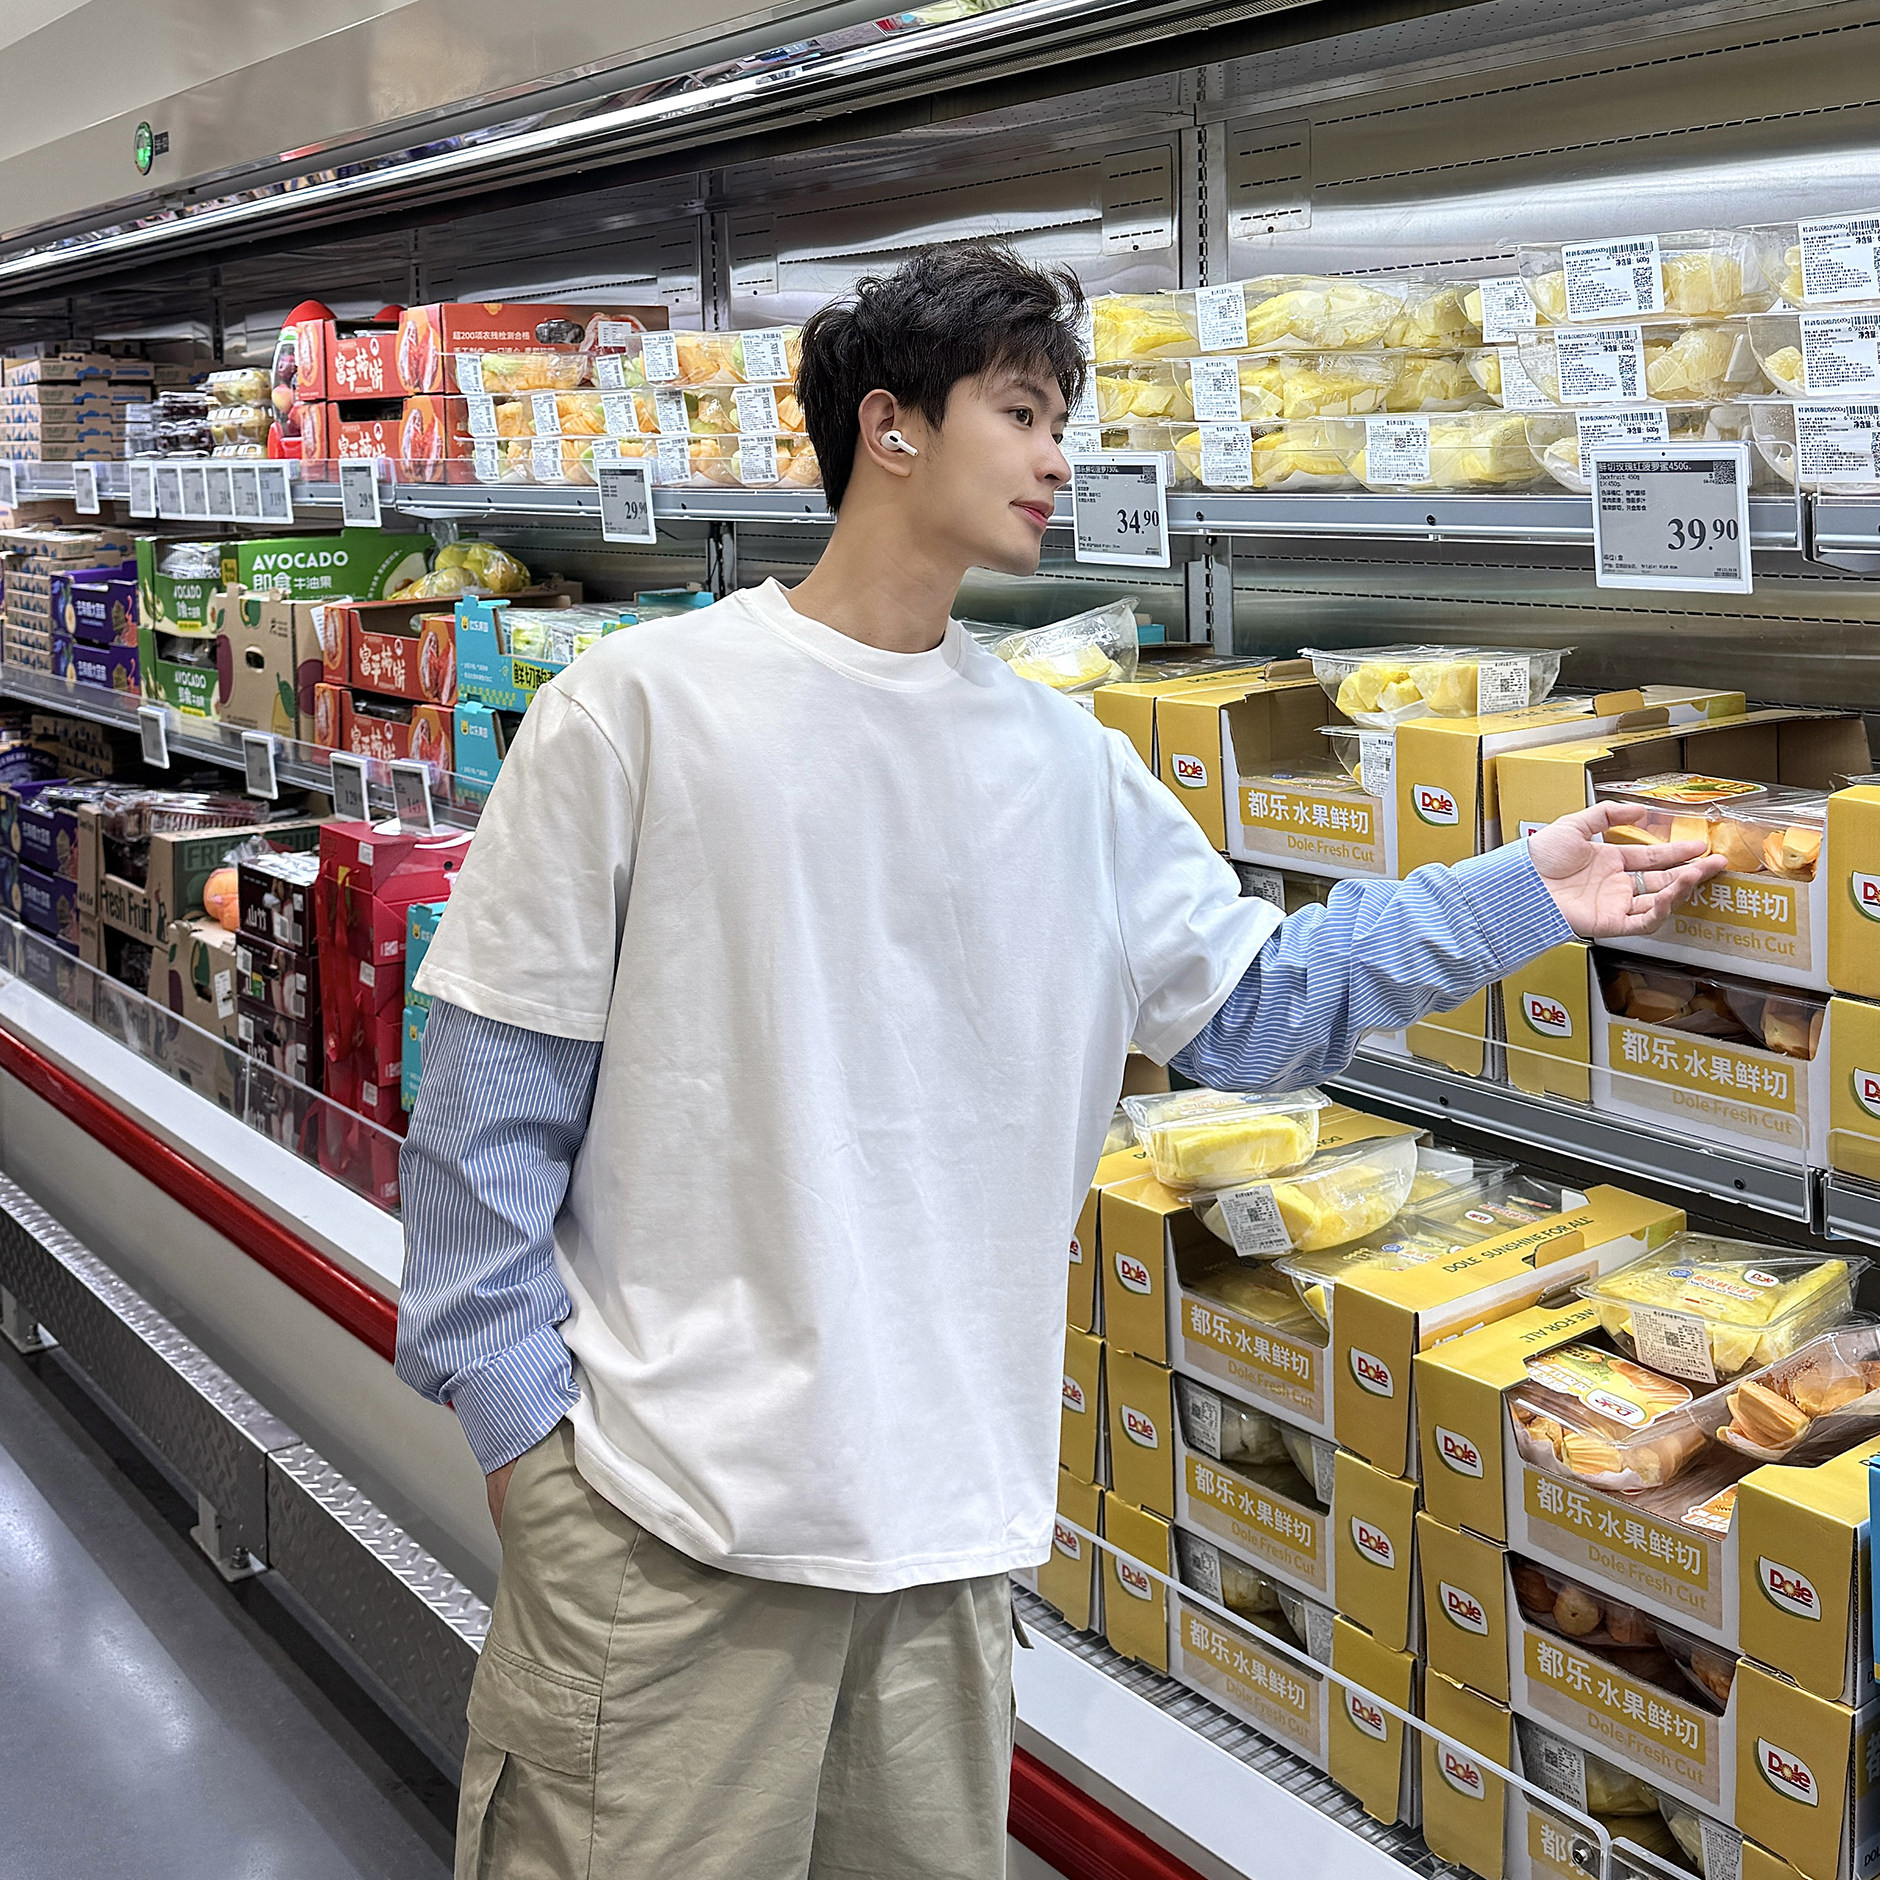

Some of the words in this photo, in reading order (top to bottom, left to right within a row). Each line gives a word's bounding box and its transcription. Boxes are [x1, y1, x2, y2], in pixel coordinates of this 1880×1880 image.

[1117, 509, 1160, 534] 34.90
[1667, 518, 1739, 550] 39.90
[252, 551, 348, 571] AVOCADO
[252, 572, 291, 591] 即食
[293, 576, 332, 589] 牛油果
[1178, 759, 1203, 776] Dole
[1248, 789, 1290, 821] 都乐
[1292, 801, 1369, 835] 水果鲜切
[1421, 791, 1453, 812] Dole
[1287, 834, 1314, 852] Dole
[1317, 840, 1349, 859] Fresh
[1352, 847, 1374, 863] Cut
[100, 878, 126, 923] Fresh
[128, 890, 152, 935] Fruit
[1674, 918, 1712, 939] Dole
[1715, 927, 1761, 950] Fresh
[1764, 935, 1795, 957] Cut
[1531, 1001, 1566, 1025] Dole
[1622, 1028, 1679, 1071] 都乐
[1683, 1050, 1788, 1100] 水果鲜切
[1672, 1090, 1712, 1114] Dole
[1715, 1099, 1758, 1124] Fresh
[1761, 1109, 1793, 1131] Cut
[1441, 1256, 1483, 1273] DOLE
[1481, 1231, 1547, 1260] SUNSHINE
[1543, 1225, 1570, 1239] FOR
[1121, 1260, 1147, 1283] Dole
[1190, 1303, 1231, 1346] 都乐
[1234, 1327, 1310, 1380] 水果鲜切
[1228, 1358, 1256, 1383] Dole
[1357, 1356, 1389, 1384] Dole
[1127, 1412, 1153, 1437] Dole
[1444, 1434, 1478, 1466] Dole
[1195, 1462, 1236, 1507] 都乐
[1238, 1490, 1312, 1548] 水果鲜切
[1055, 1523, 1077, 1547] Dole
[1358, 1525, 1390, 1556] Dole
[1537, 1477, 1594, 1529] 都乐
[1598, 1510, 1701, 1576] 水果鲜切
[1231, 1521, 1257, 1545] Dole
[1259, 1533, 1292, 1561] Fresh
[1294, 1549, 1316, 1575] Cut
[1121, 1564, 1147, 1588] Dole
[1588, 1543, 1627, 1572] Dole
[1627, 1560, 1673, 1595] Fresh
[1676, 1578, 1708, 1610] Cut
[1769, 1569, 1813, 1605] Dole
[1447, 1592, 1482, 1623] Dole
[1189, 1618, 1230, 1663] 都乐
[1233, 1649, 1306, 1711] 水果鲜切
[1225, 1676, 1252, 1704] Dole
[1536, 1640, 1594, 1697] 都乐
[1598, 1677, 1700, 1752] 水果鲜切
[1352, 1696, 1383, 1728] Dole
[1587, 1710, 1626, 1743] Dole
[1627, 1728, 1672, 1768] Fresh
[1674, 1749, 1705, 1785] Cut
[1445, 1752, 1479, 1787] Dole
[1767, 1749, 1811, 1788] Dole
